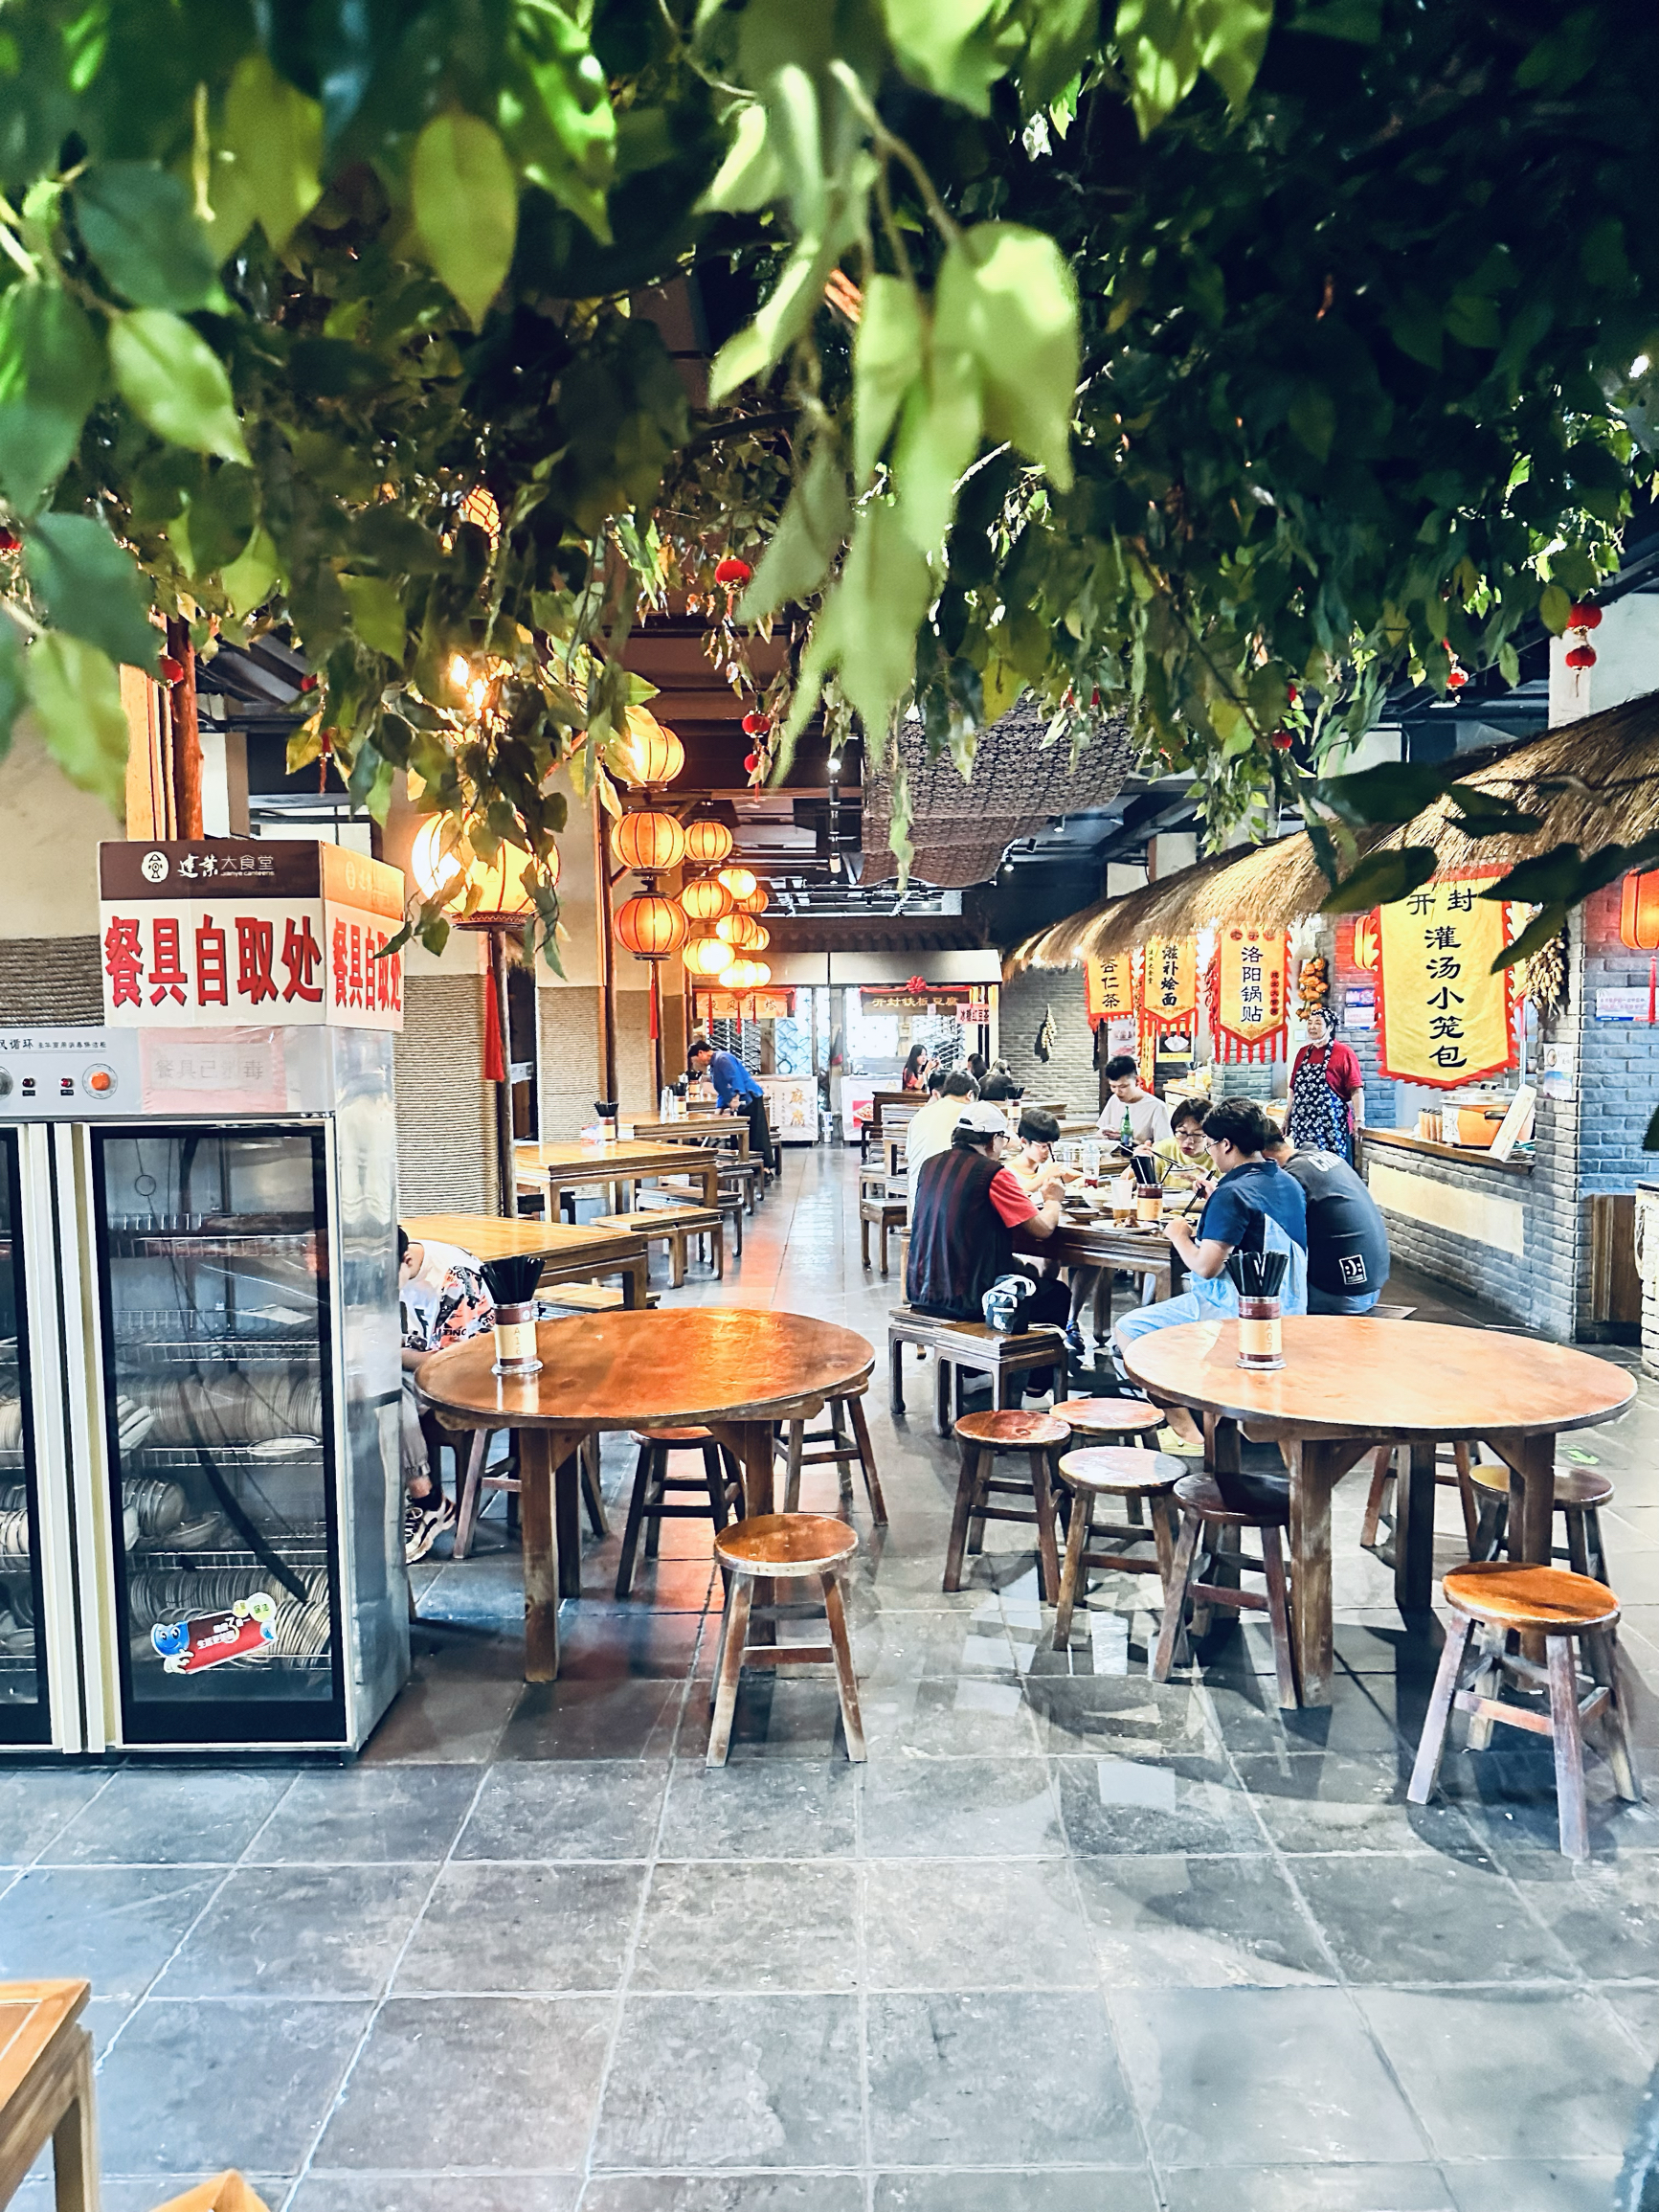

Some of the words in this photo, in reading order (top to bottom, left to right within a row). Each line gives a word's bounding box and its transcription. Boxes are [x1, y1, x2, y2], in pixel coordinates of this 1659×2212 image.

[1406, 889, 1477, 915] 开封
[105, 914, 324, 1007] 餐具自取处
[332, 917, 402, 1012] 餐具自取处
[1160, 945, 1179, 1006] 滋补烩面
[1241, 946, 1264, 1023] 洛阳锅贴
[1424, 925, 1468, 1069] 灌汤小笼包
